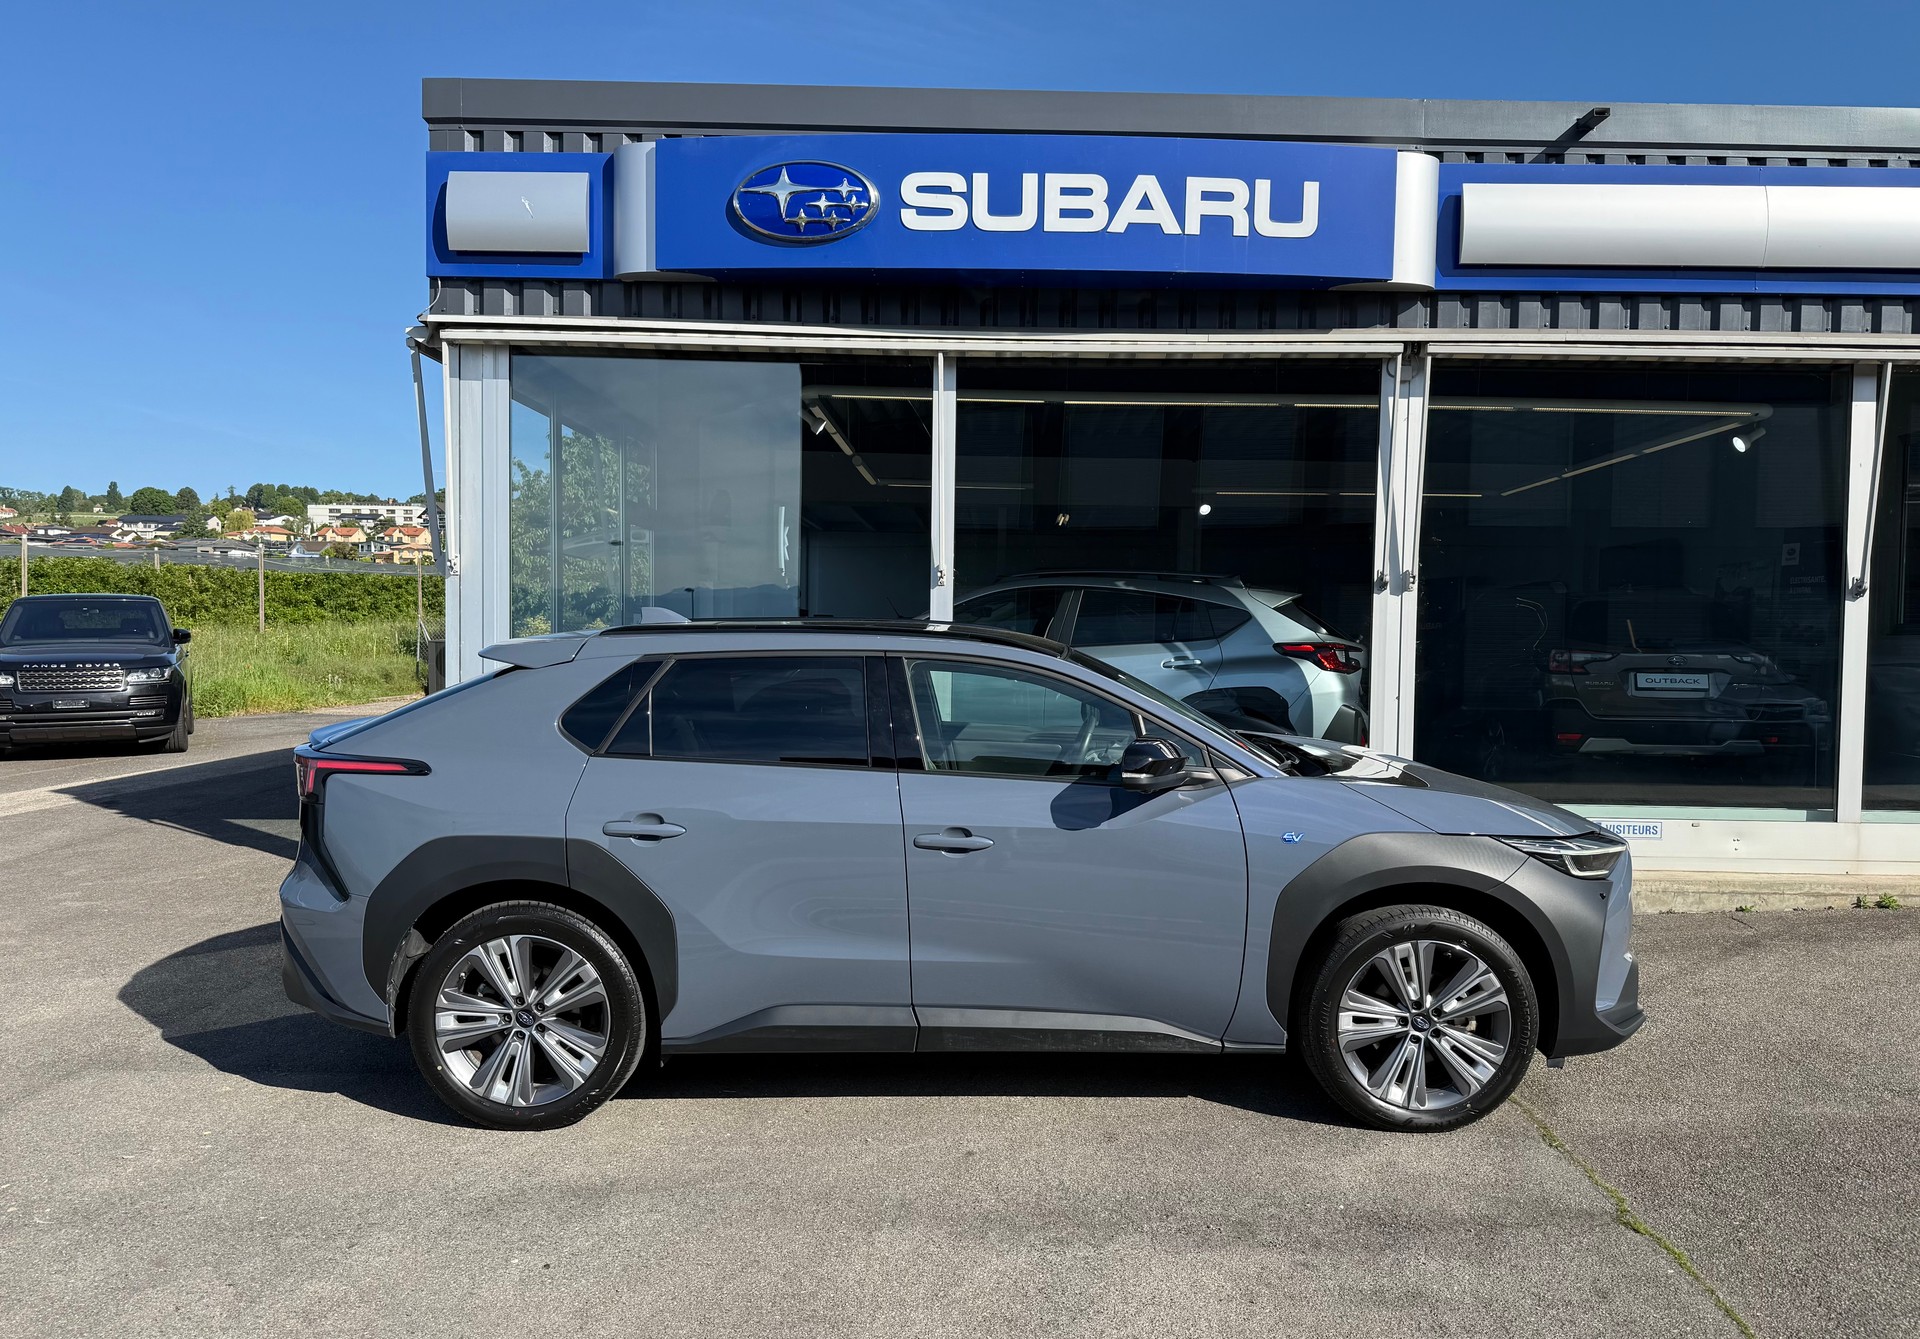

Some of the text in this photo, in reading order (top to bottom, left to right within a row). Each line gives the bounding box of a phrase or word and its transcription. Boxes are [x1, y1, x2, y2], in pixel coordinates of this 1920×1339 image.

[900, 172, 1320, 238] SUBARU
[1645, 677, 1701, 685] OUTBACK
[1605, 824, 1658, 835] VISITEURS
[1281, 831, 1305, 844] EV
